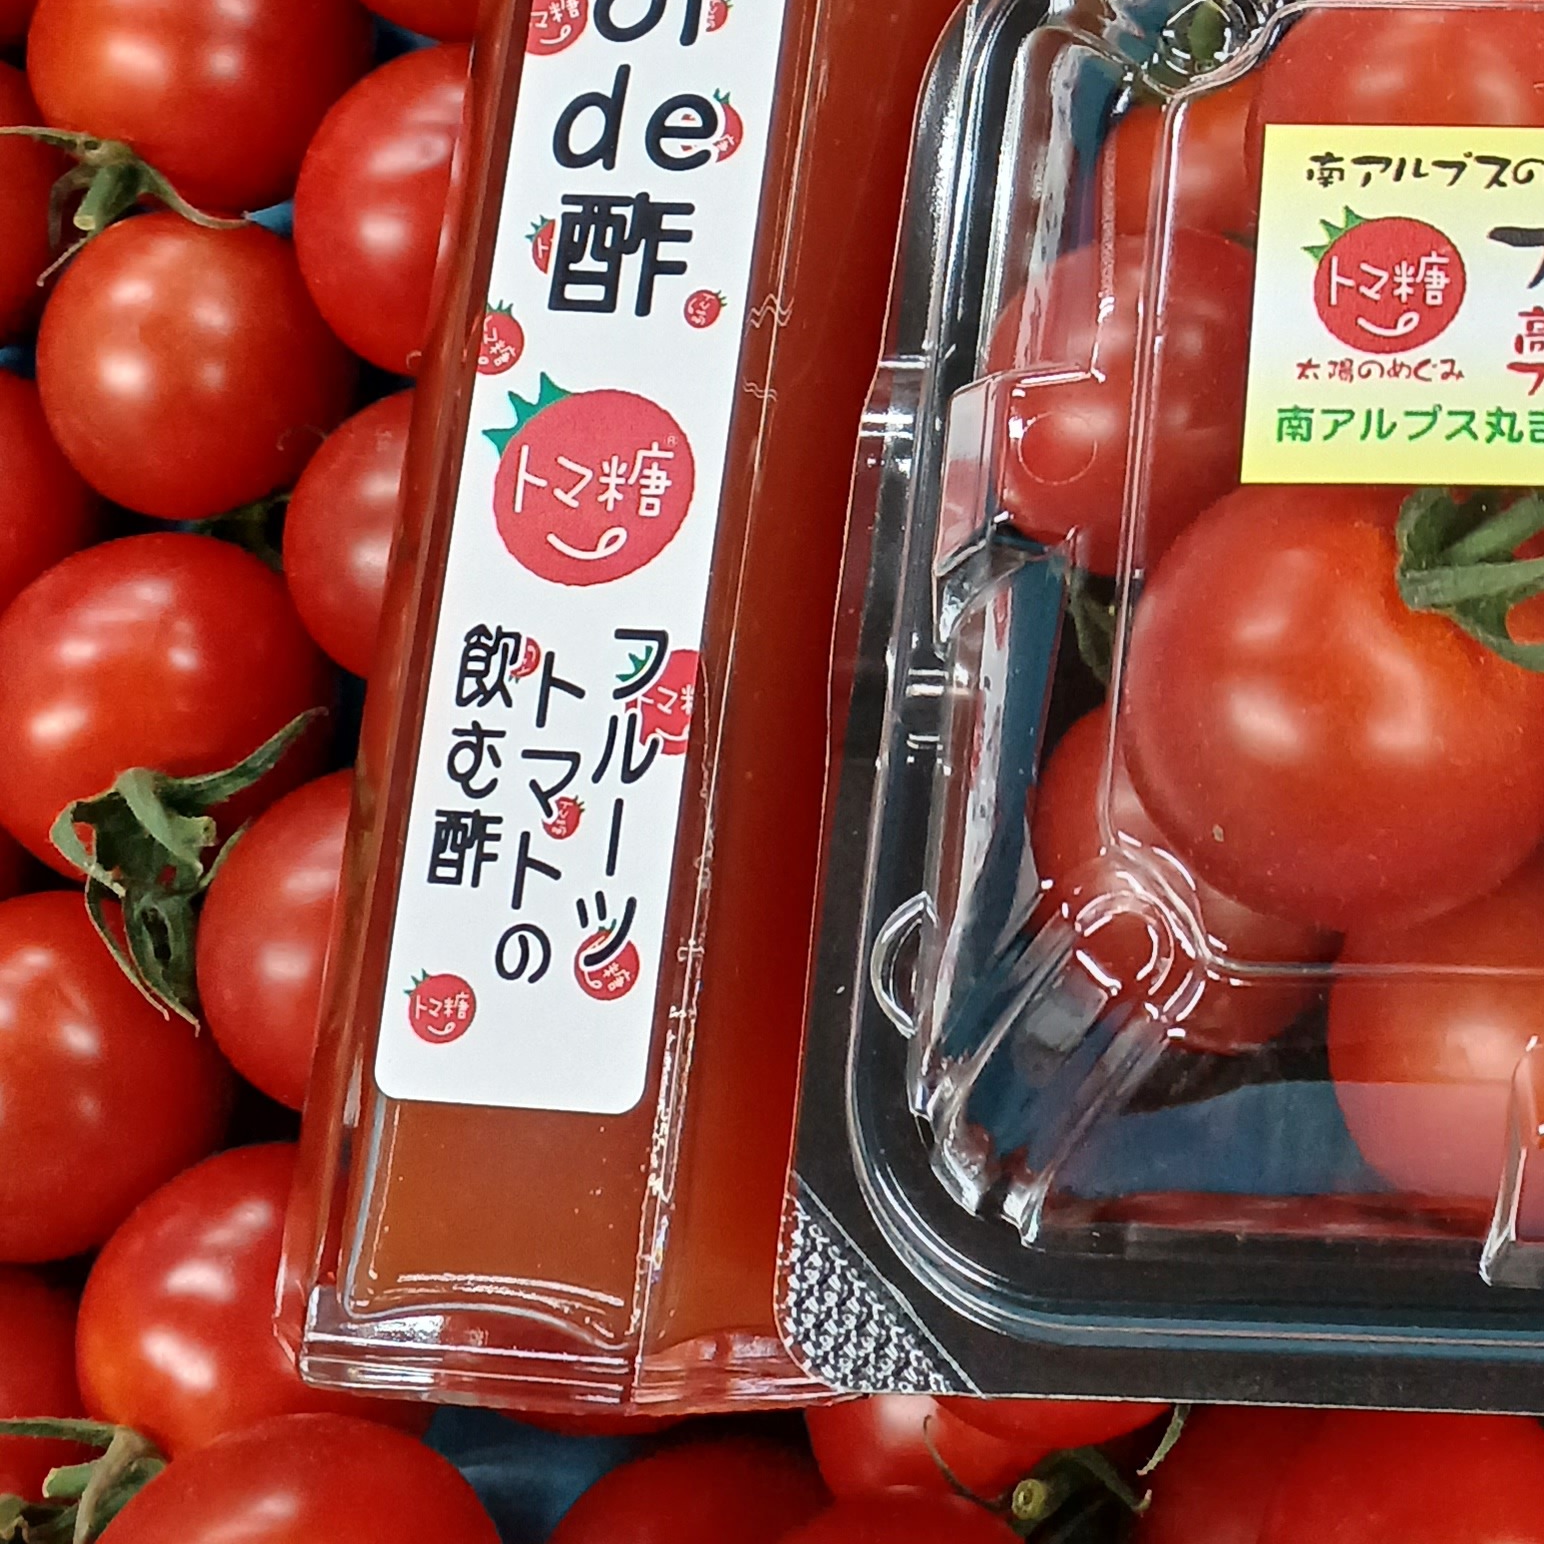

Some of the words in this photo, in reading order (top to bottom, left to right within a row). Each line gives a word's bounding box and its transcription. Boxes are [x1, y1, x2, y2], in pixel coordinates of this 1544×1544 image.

[1329, 251, 1450, 306] トマ糖
[1295, 359, 1465, 383] 太陽のめぐみ
[514, 441, 674, 518] トマ糖
[426, 623, 522, 889] 飲む酢
[493, 649, 586, 985] トマトの
[576, 628, 669, 969] フルーツ
[416, 992, 466, 1019] トマ糖
